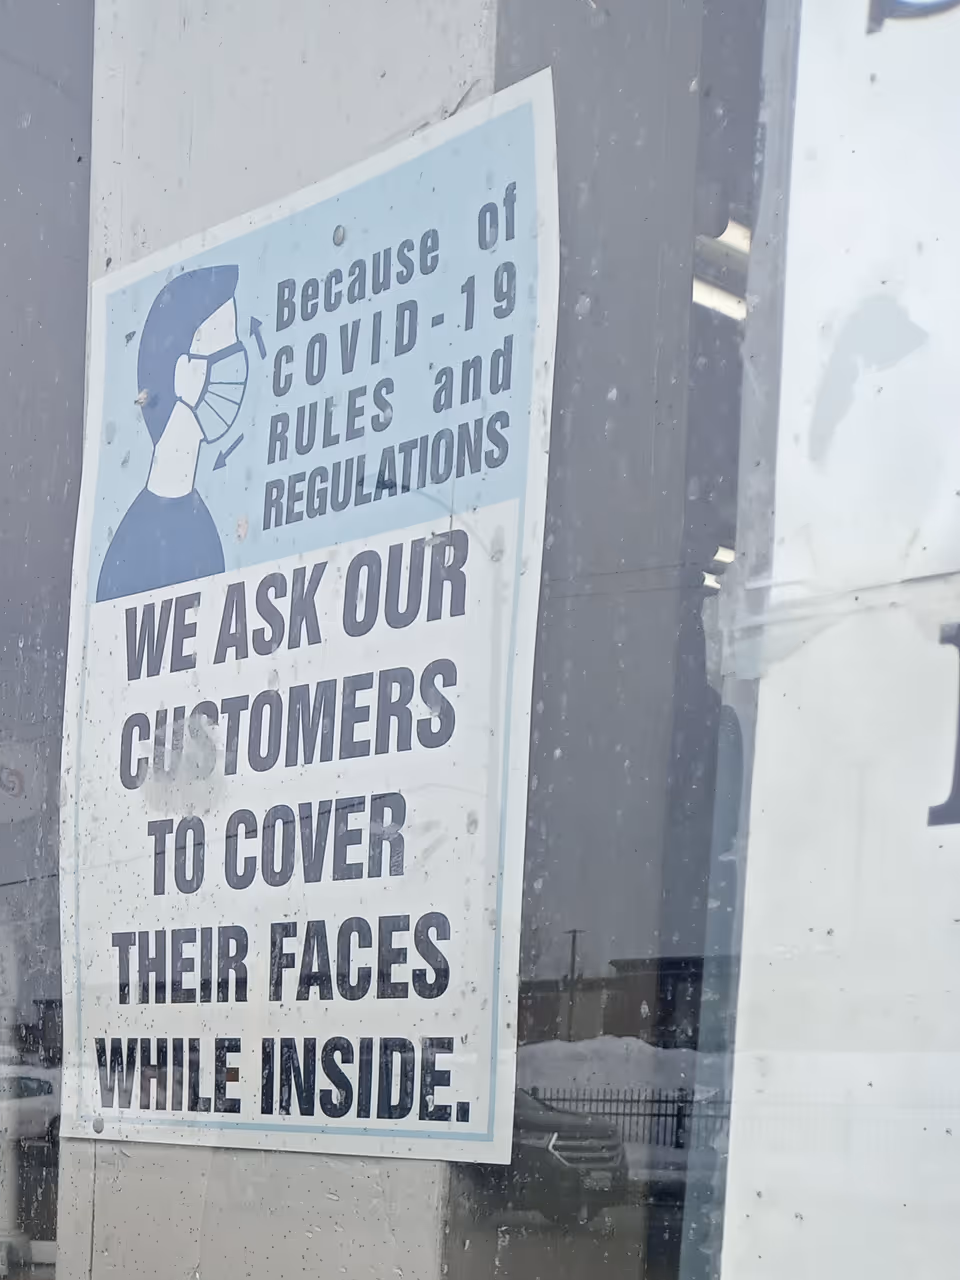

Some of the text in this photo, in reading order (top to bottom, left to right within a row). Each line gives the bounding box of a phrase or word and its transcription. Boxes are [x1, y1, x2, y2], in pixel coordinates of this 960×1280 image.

[275, 182, 517, 331] Because of
[273, 261, 516, 397] COVID-19
[267, 336, 513, 464] RULES and
[263, 411, 510, 531] REGULATIONS
[125, 529, 468, 680] WE ASK OUR
[120, 658, 458, 790] CUSTOMERS
[148, 791, 407, 895] TO COVER
[112, 911, 451, 1005] THEIR FACES
[95, 1036, 469, 1123] WHILE INSIDE.
